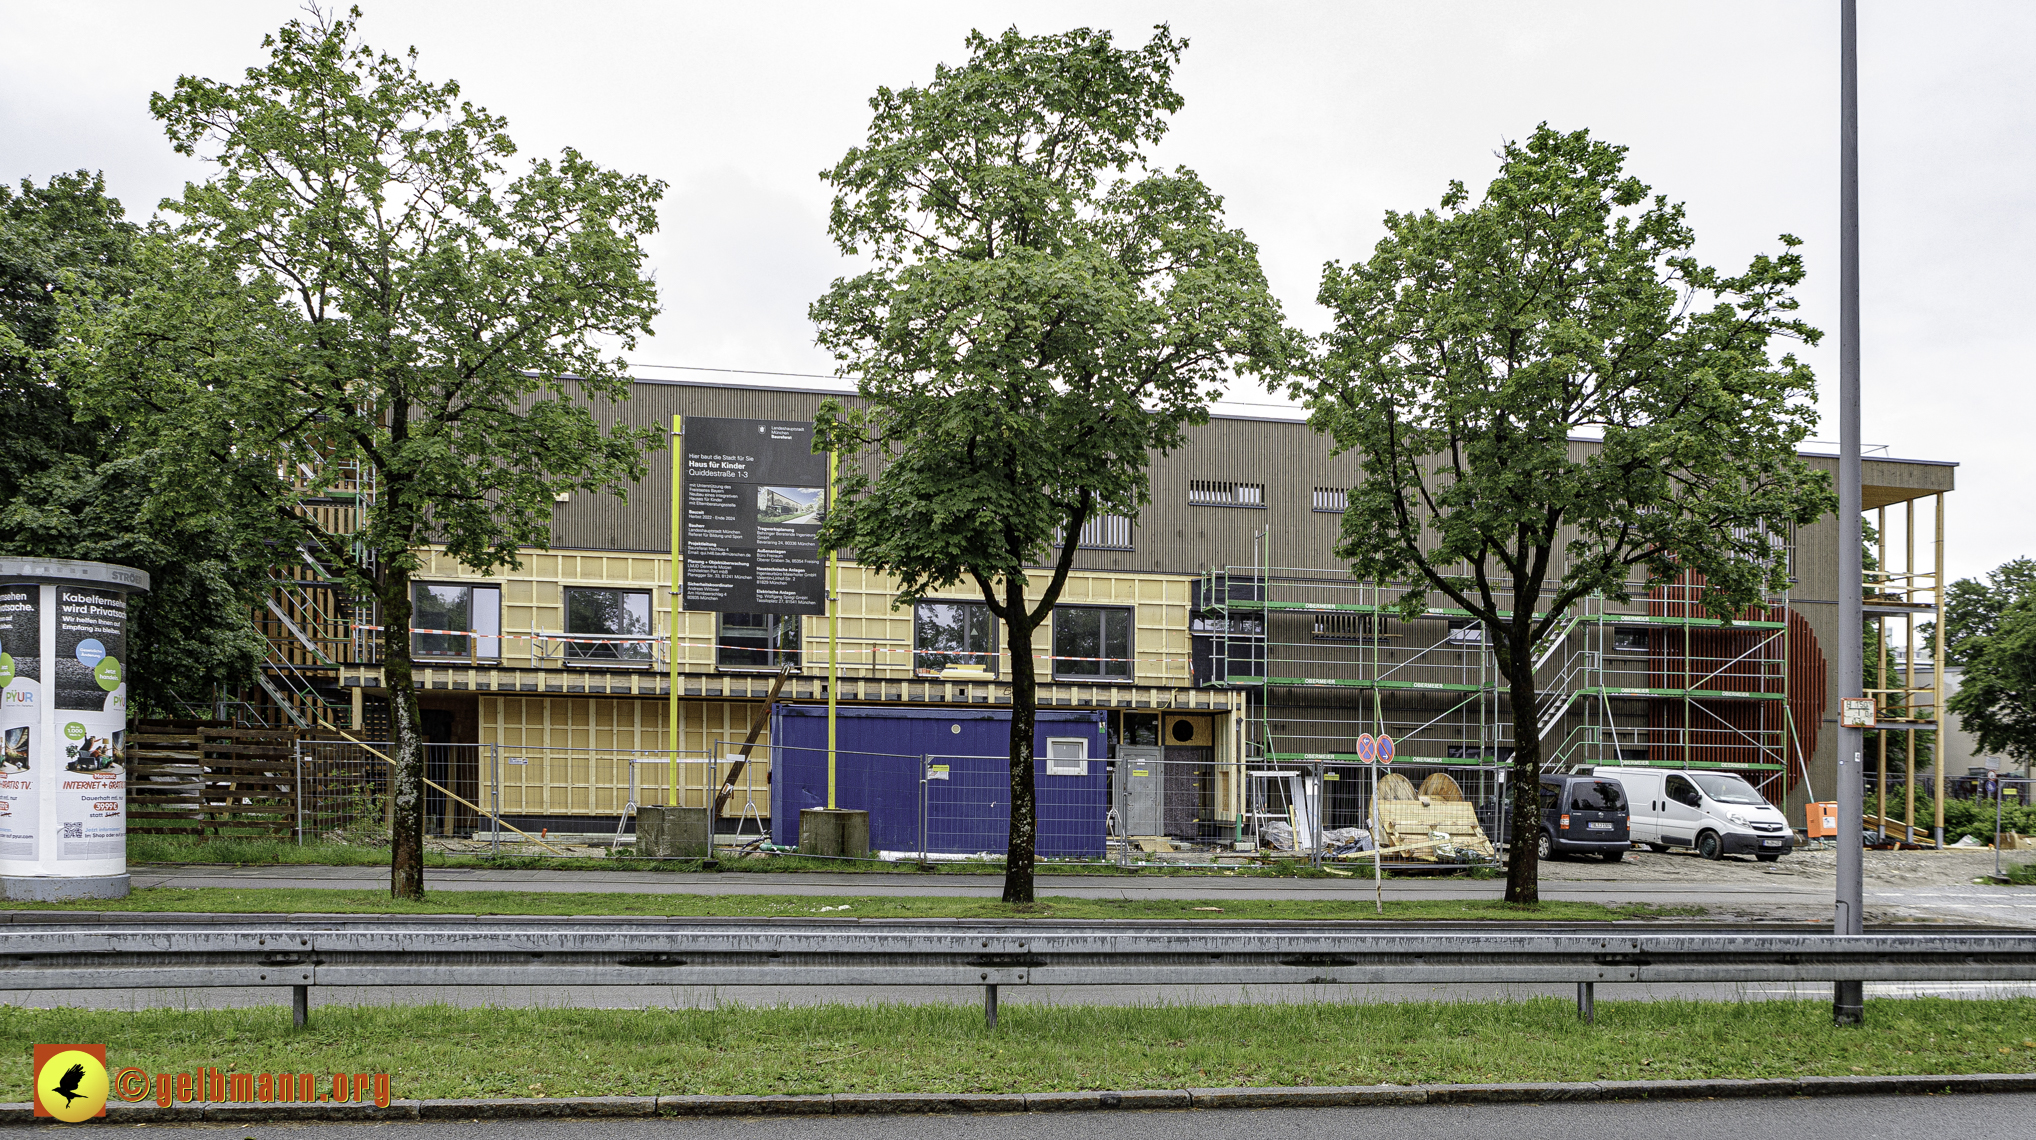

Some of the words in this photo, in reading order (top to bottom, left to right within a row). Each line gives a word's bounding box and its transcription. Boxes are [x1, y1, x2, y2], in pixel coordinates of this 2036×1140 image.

[689, 469, 735, 477] Quiddestraße
[62, 604, 87, 613] wird
[62, 624, 93, 632] Empfang
[63, 781, 101, 789] INTERNET
